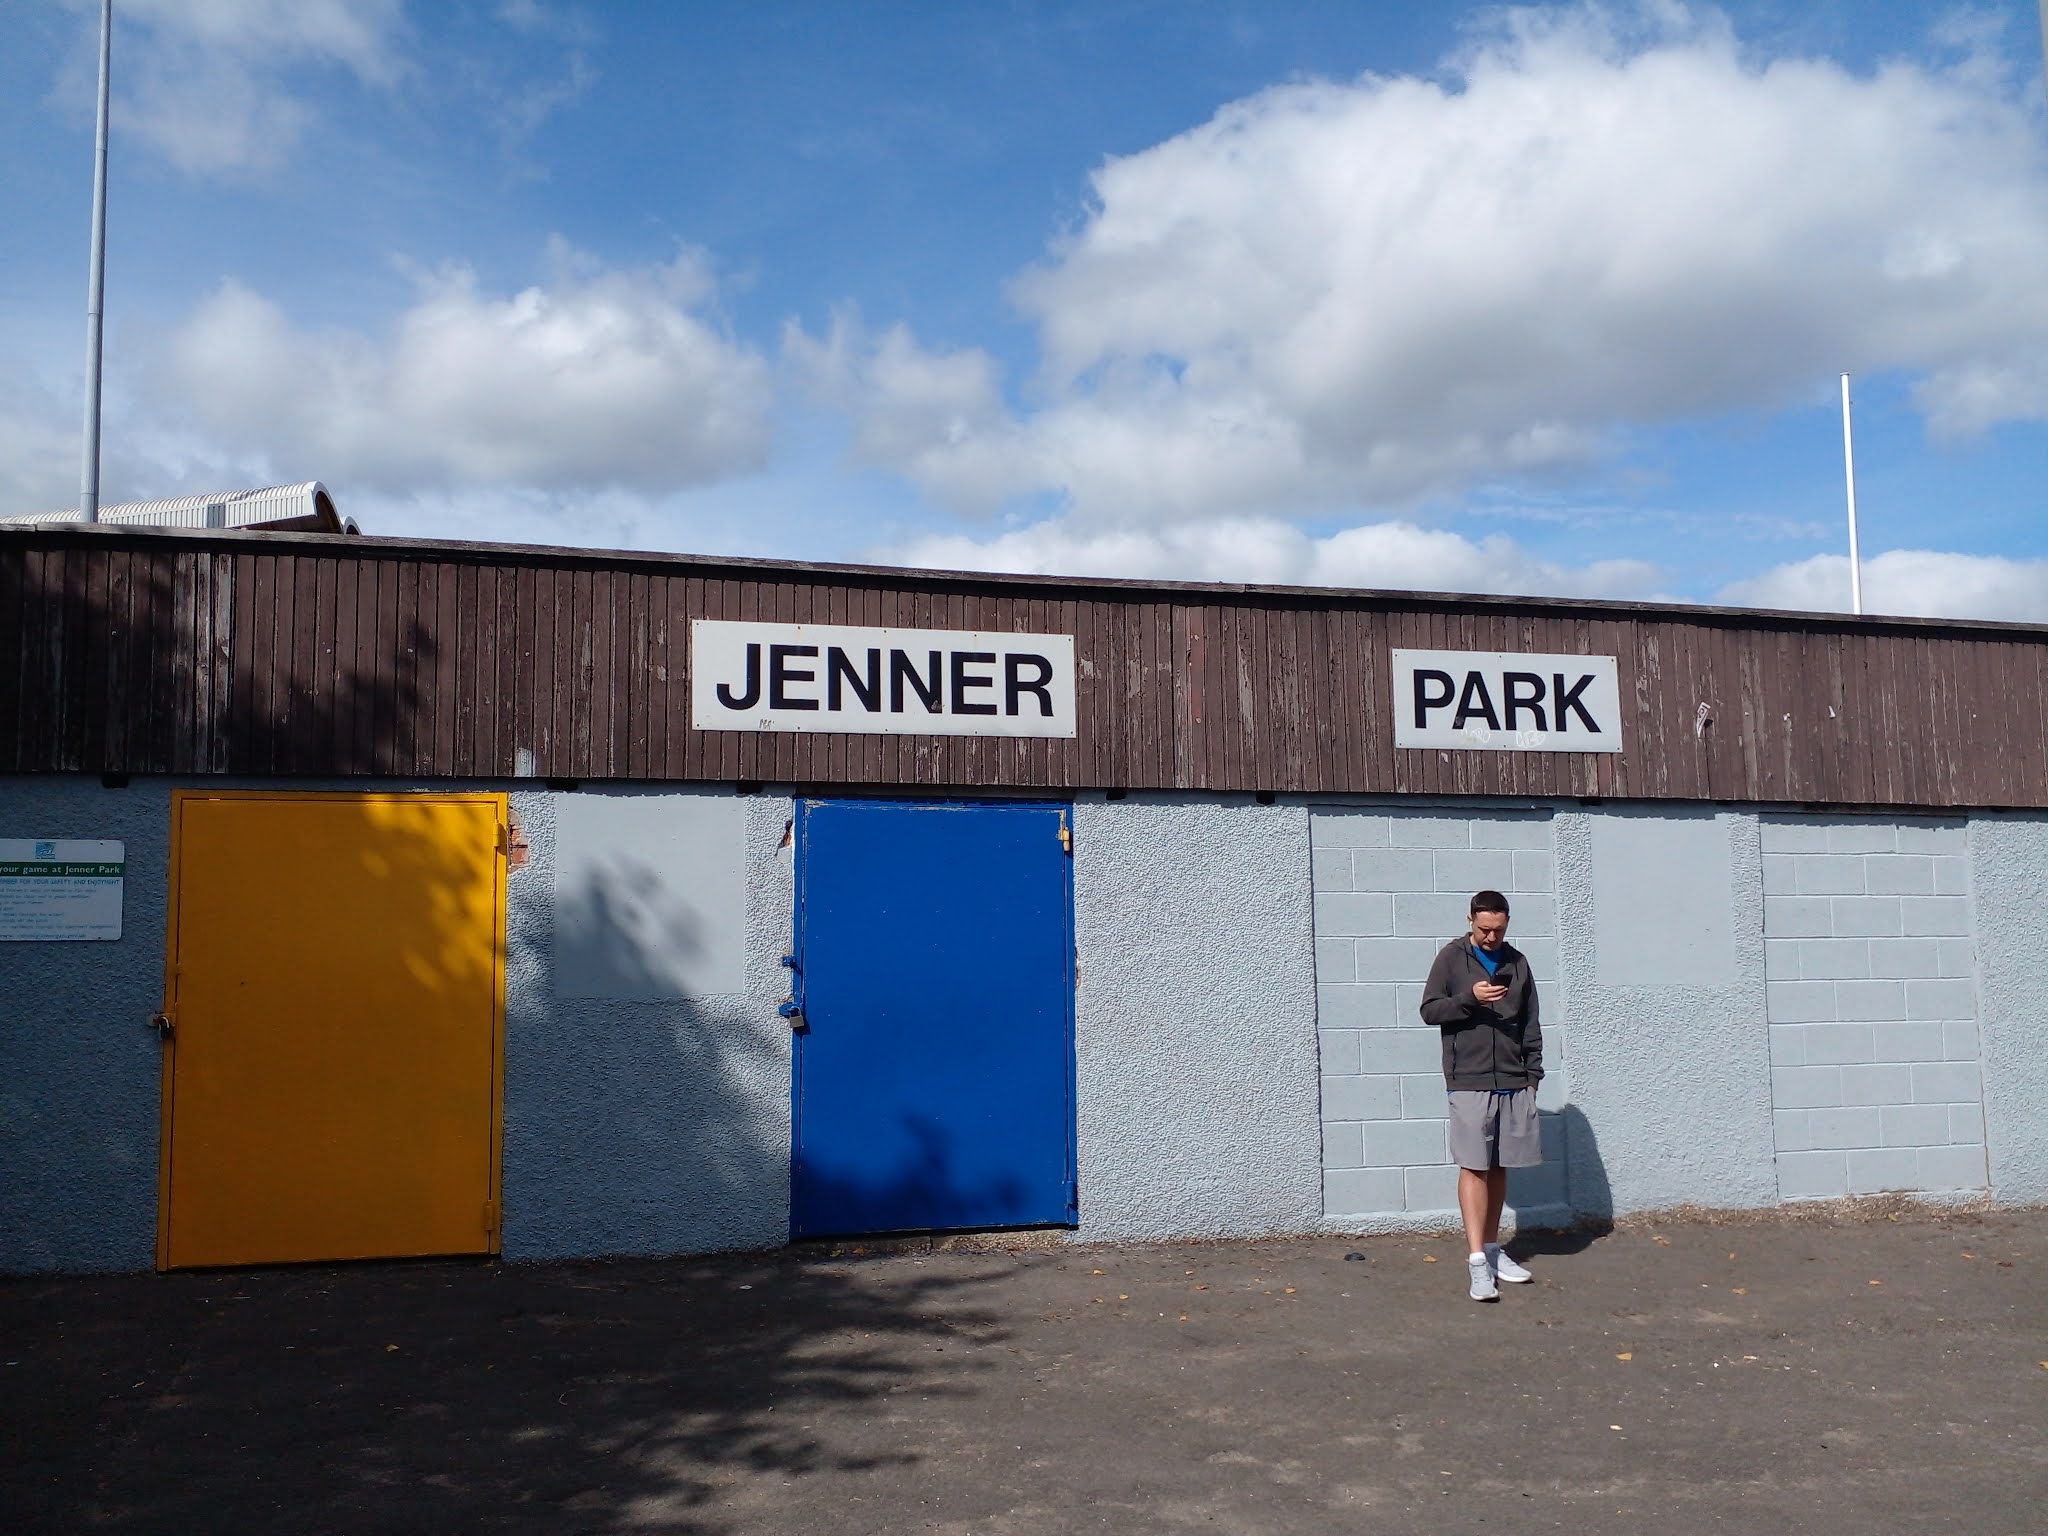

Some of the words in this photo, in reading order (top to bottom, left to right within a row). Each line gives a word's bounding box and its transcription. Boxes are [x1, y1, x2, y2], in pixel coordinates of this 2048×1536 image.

[716, 643, 1054, 717] JENNER
[1413, 669, 1602, 733] PARK
[22, 866, 48, 875] game
[64, 865, 95, 875] Jenner
[98, 865, 120, 874] Park
